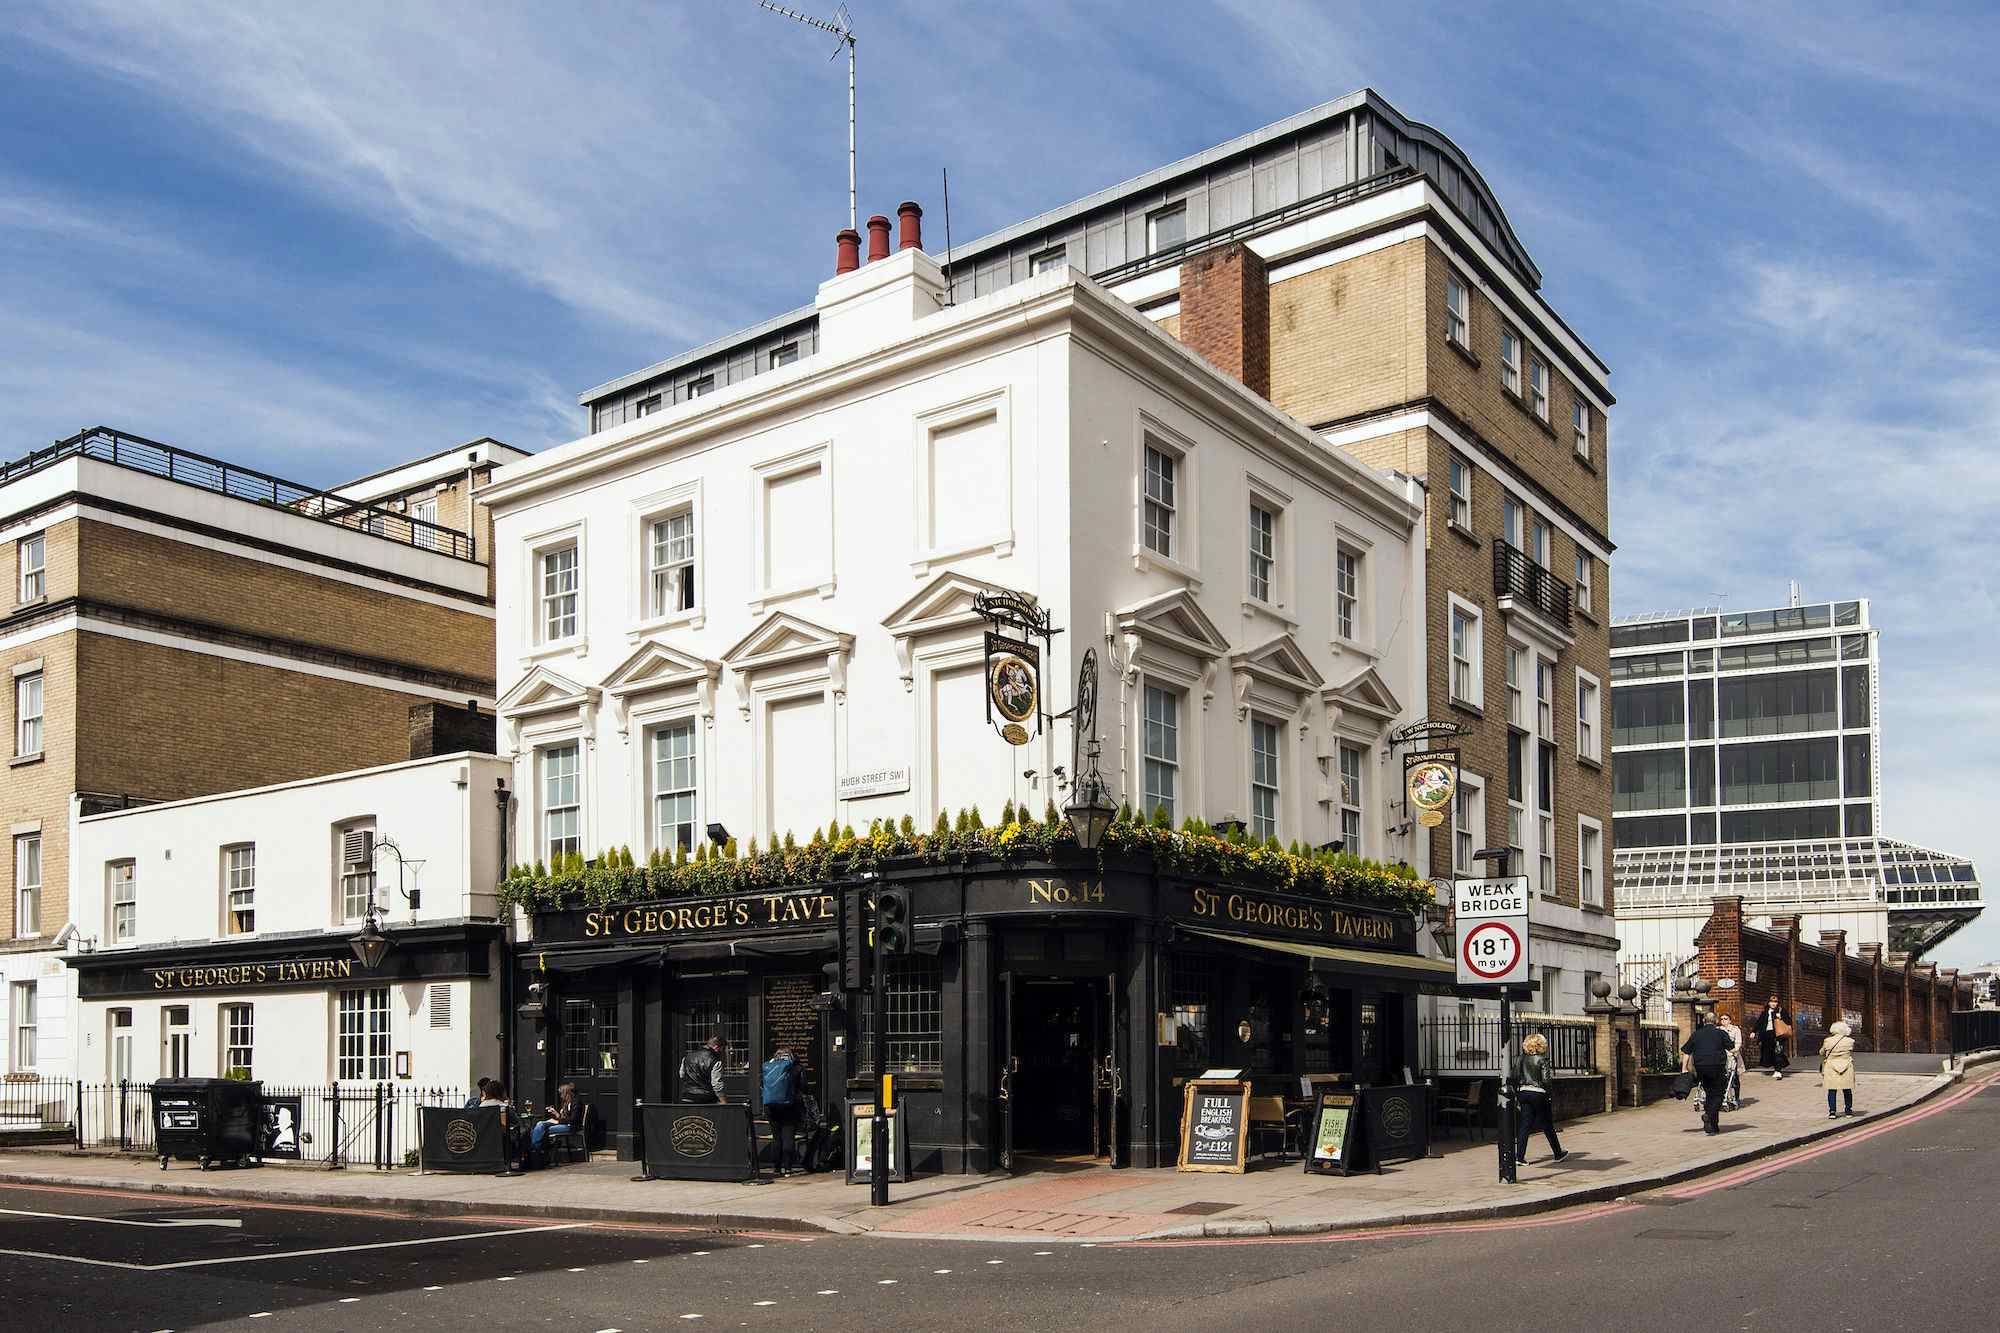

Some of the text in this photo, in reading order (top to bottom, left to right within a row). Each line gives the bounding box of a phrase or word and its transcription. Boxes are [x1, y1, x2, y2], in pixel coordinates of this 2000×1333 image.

[1414, 722, 1457, 732] NICHOLSON
[841, 769, 904, 787] HUGH STREET SW1
[1468, 883, 1515, 897] WEAK
[1461, 898, 1522, 912] BRIDGE
[585, 912, 615, 937] ST
[624, 900, 749, 934] GEORGE'S
[1193, 888, 1394, 940] ST GEORGE'S TAVERN
[154, 959, 351, 989] ST GEORGE'S TAVERN
[1203, 1097, 1231, 1108] FULL
[1200, 1108, 1232, 1117] ENGLISH
[1200, 1116, 1232, 1124] BREAKFAST
[1324, 1119, 1339, 1128] FISH
[1322, 1128, 1342, 1138] CHIPS
[1195, 1141, 1202, 1152] 2
